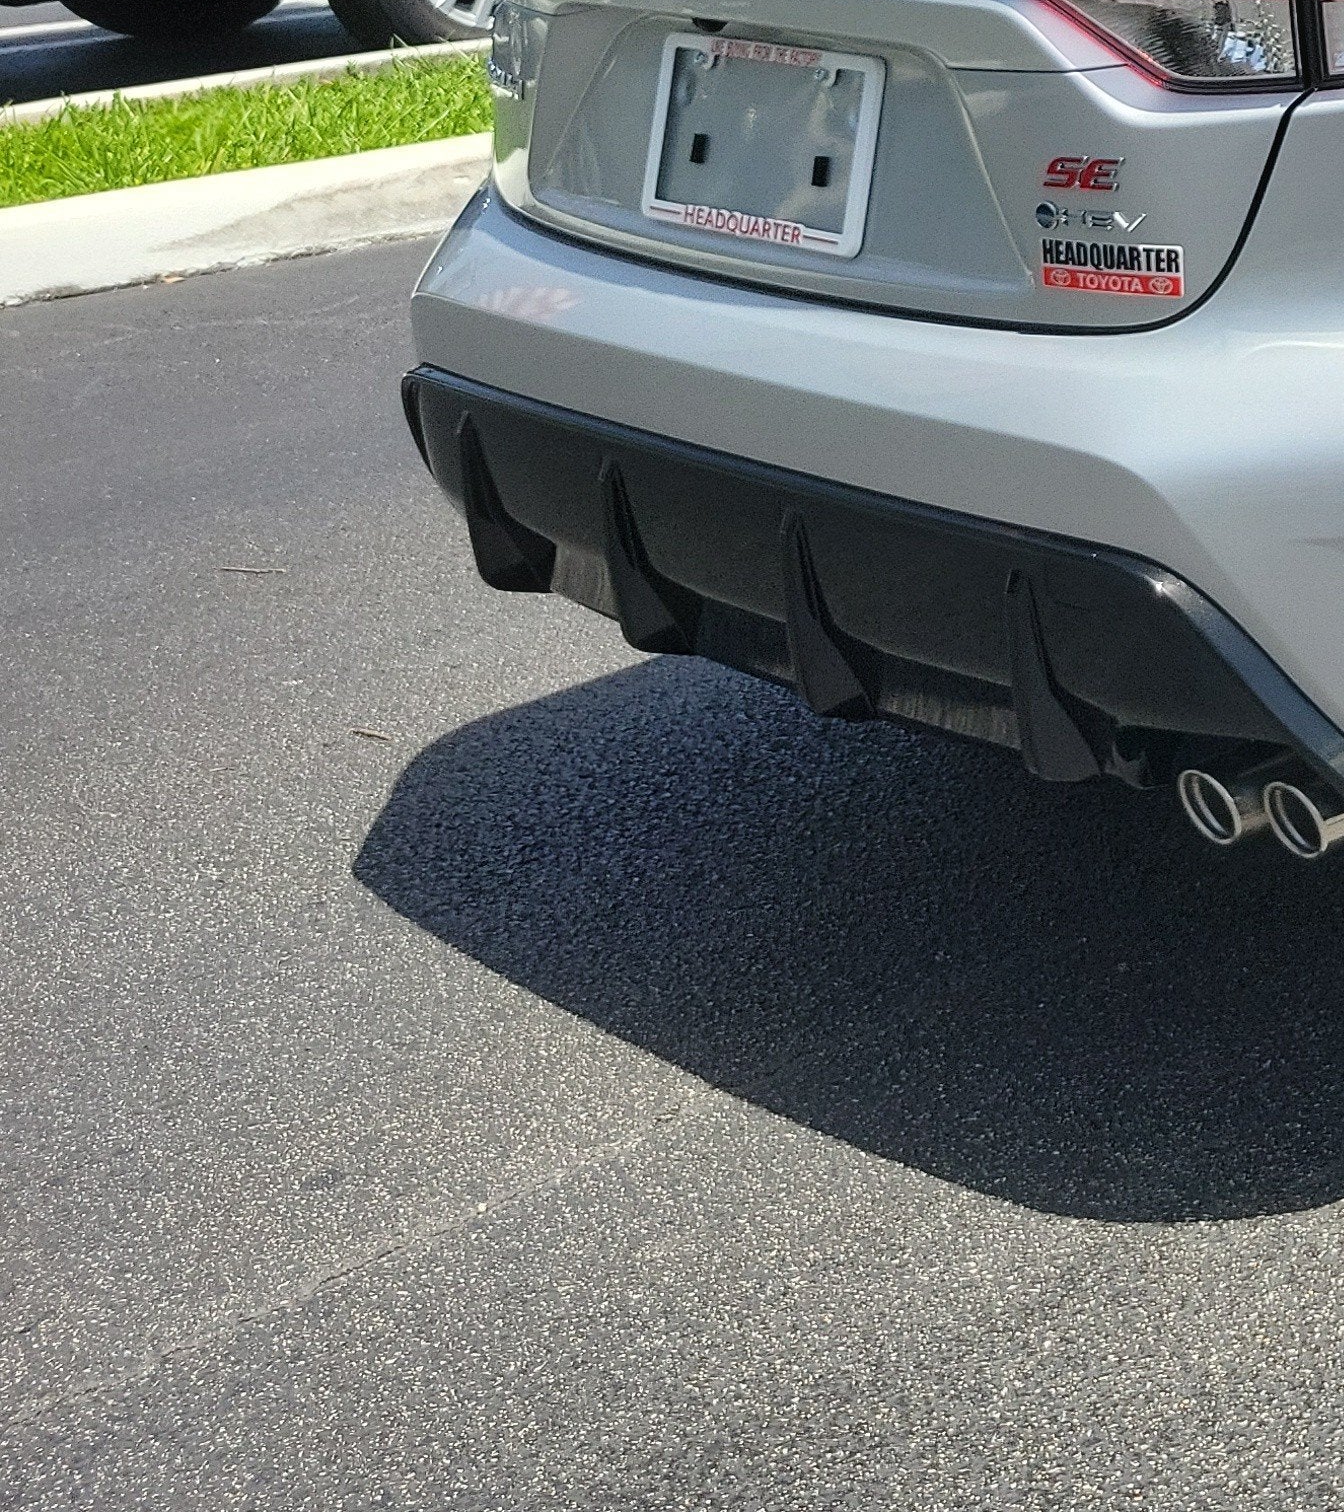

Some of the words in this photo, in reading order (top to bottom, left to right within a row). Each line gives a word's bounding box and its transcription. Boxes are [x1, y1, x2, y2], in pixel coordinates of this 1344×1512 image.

[1043, 156, 1125, 191] SE
[684, 204, 802, 244] HEADQUARTER
[1042, 238, 1181, 273] HEADQUARTER
[1076, 272, 1144, 293] TOYOTA
